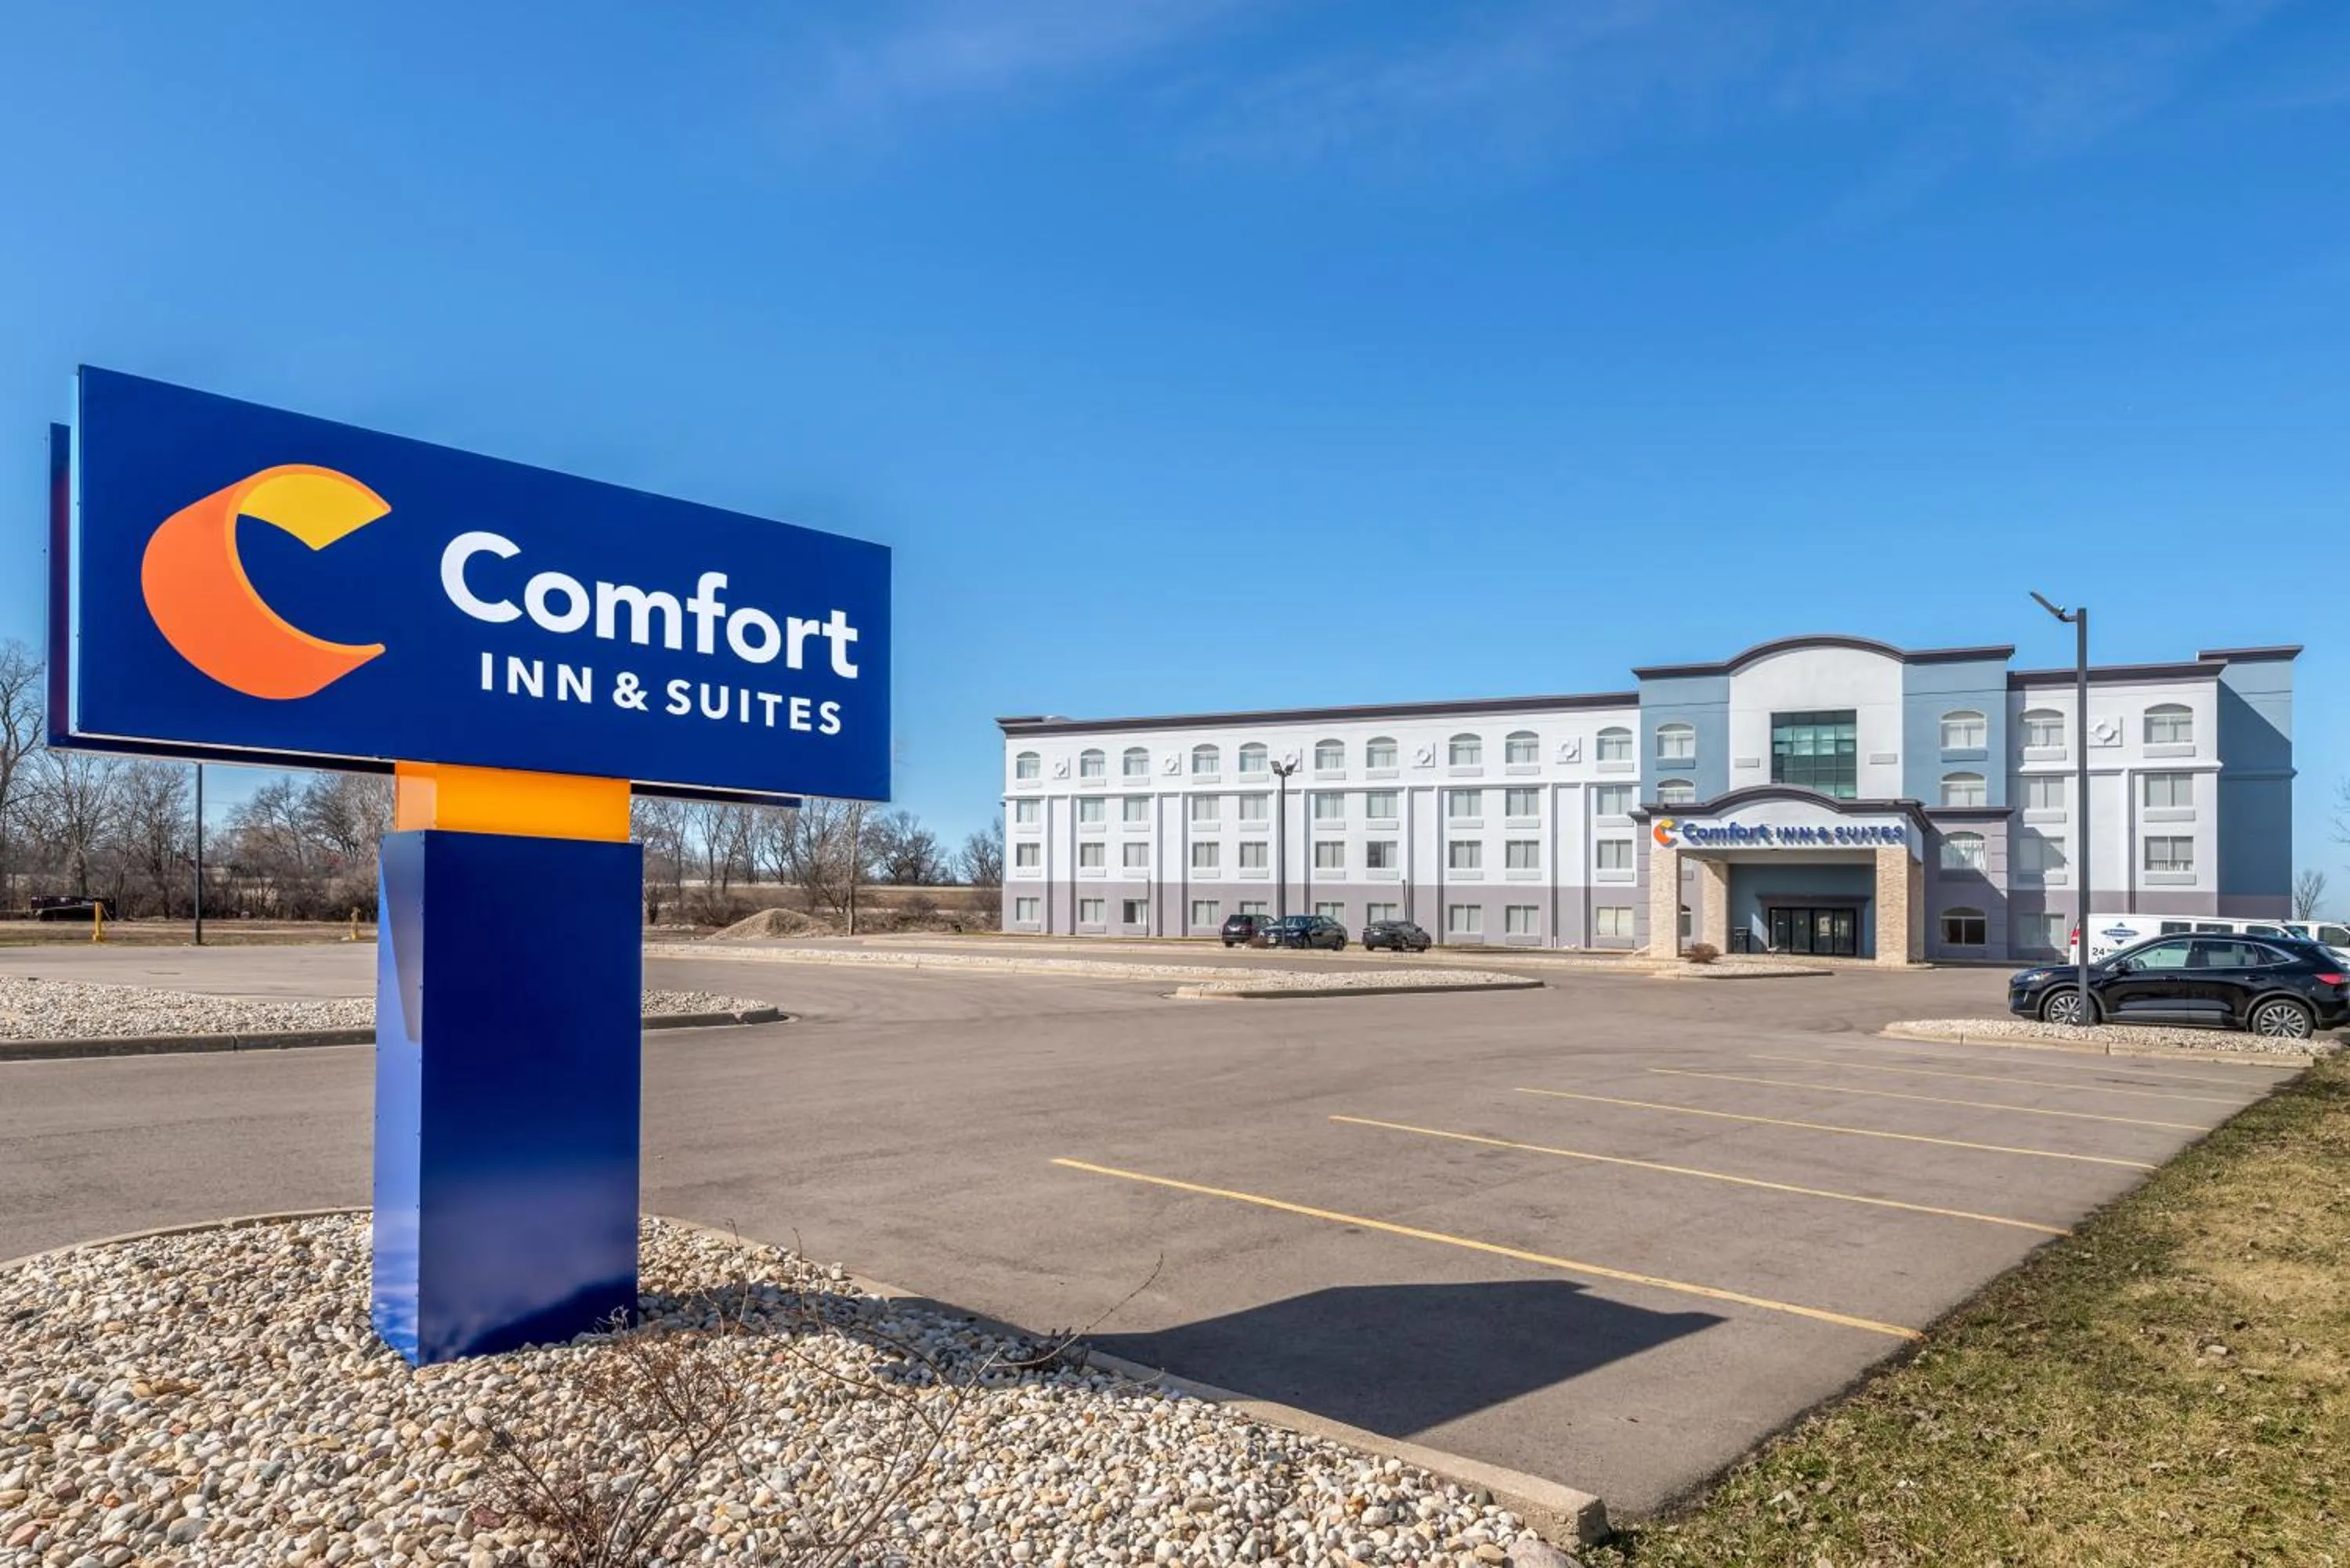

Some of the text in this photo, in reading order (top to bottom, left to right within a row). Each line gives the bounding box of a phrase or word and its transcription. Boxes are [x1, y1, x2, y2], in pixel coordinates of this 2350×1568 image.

[439, 530, 859, 680] Comfort
[481, 651, 841, 735] INN & SUITES
[1682, 822, 1904, 840] Comfort INN & SUITES
[2092, 947, 2105, 956] 24
